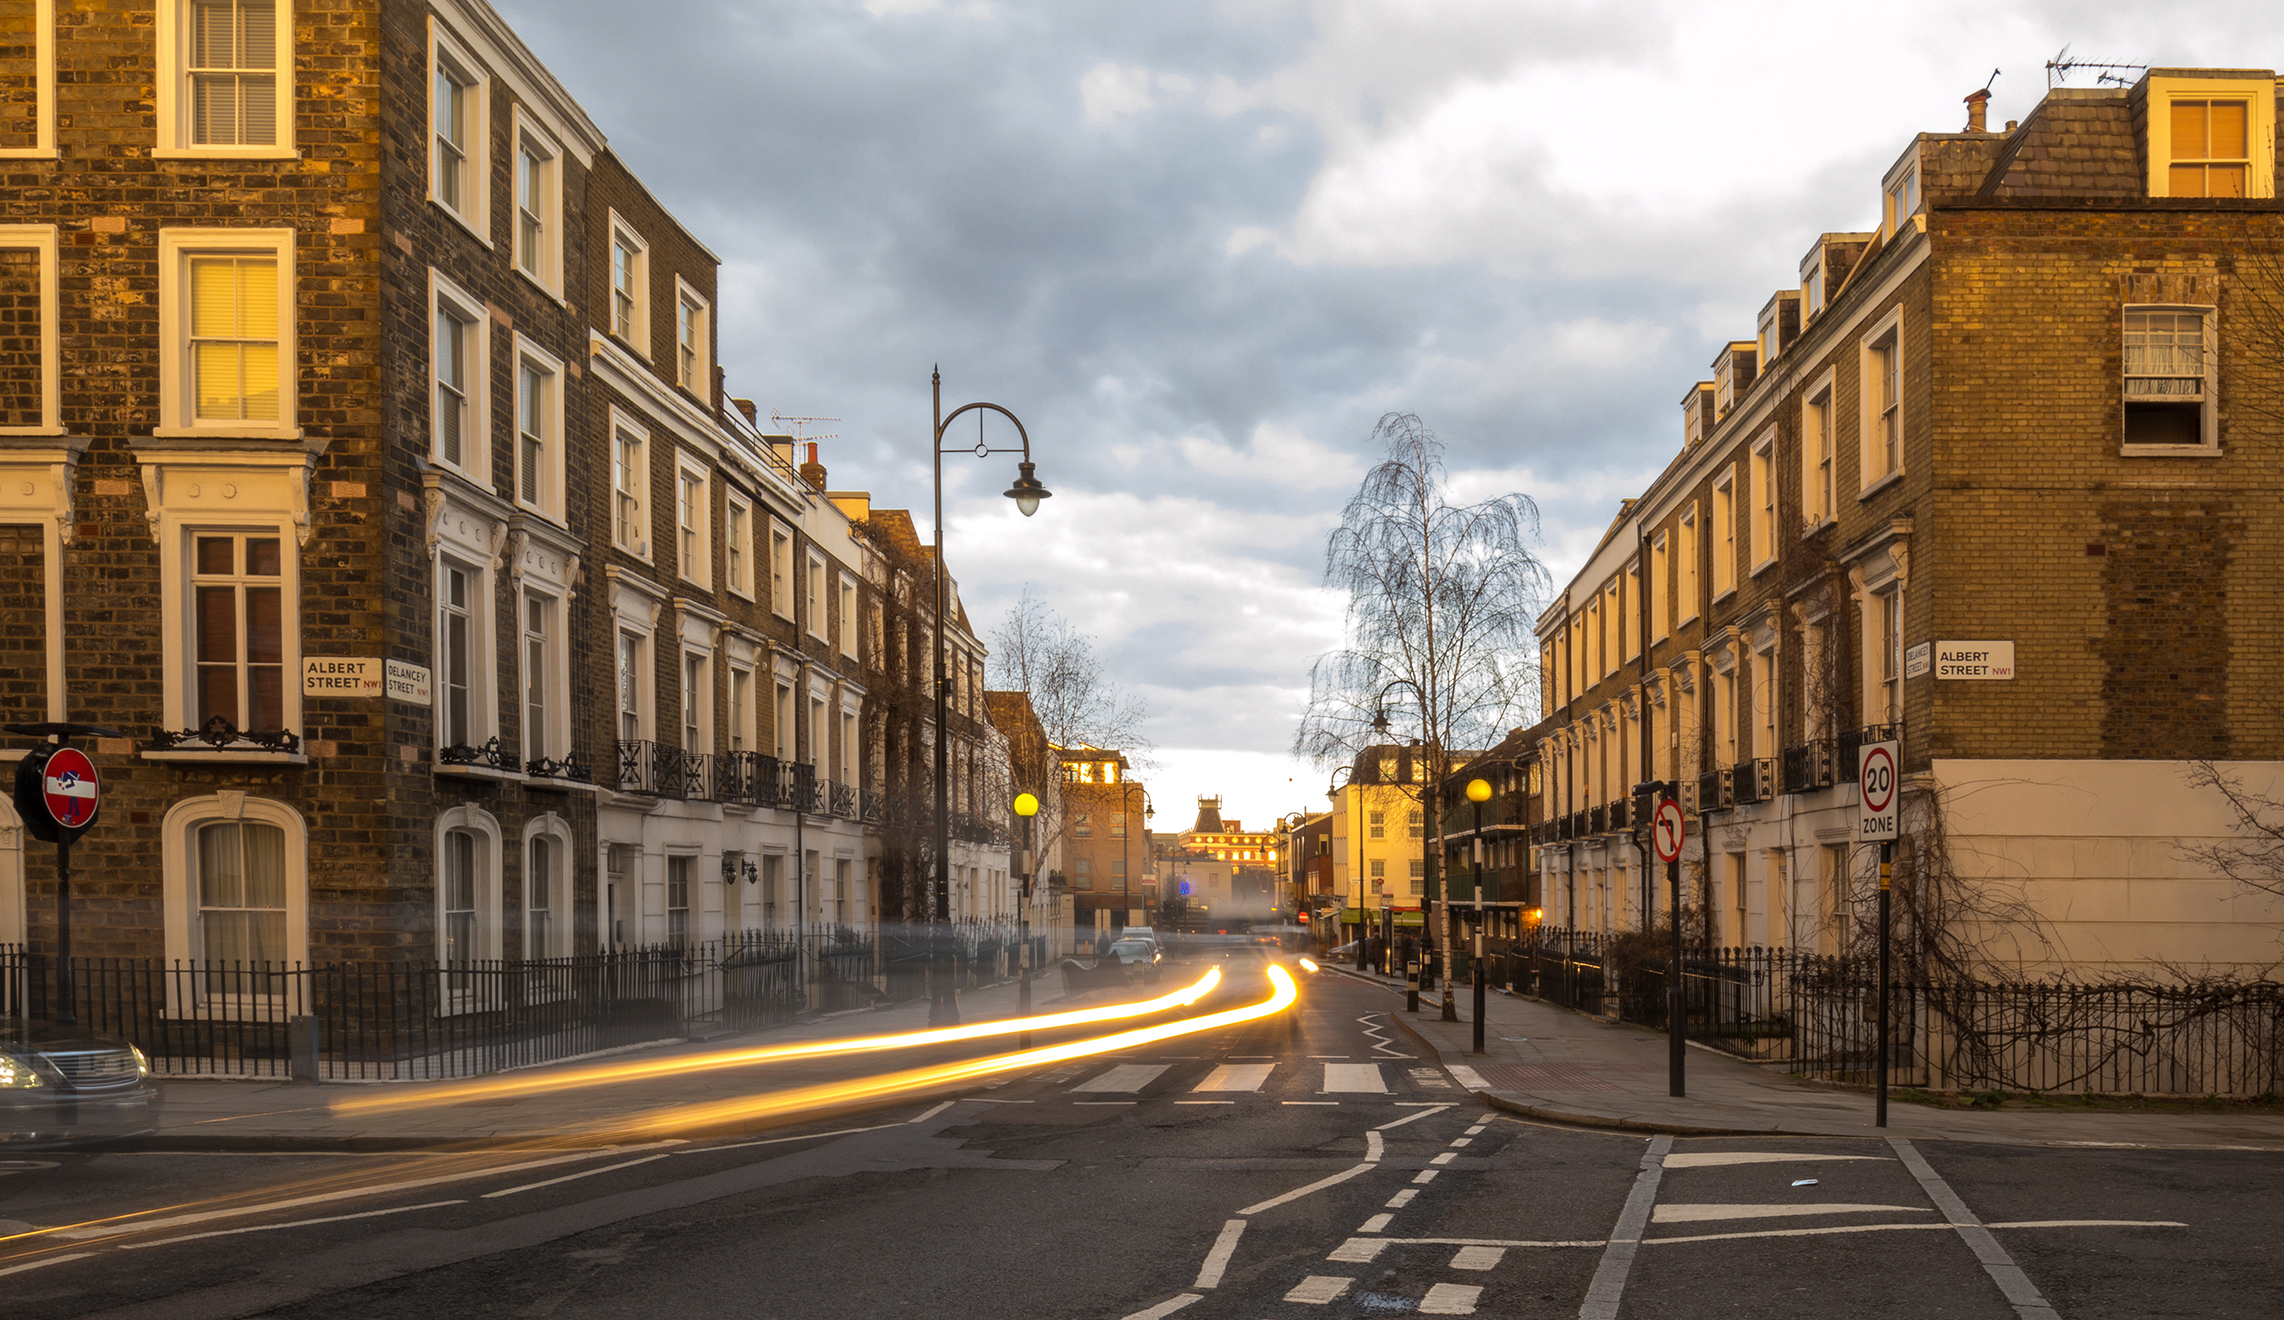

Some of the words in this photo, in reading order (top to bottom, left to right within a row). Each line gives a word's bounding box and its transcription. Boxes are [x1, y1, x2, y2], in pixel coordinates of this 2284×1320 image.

[1940, 652, 1989, 662] ALBERT
[307, 662, 365, 674] ALBERT
[388, 665, 426, 683] DELANCEY
[1940, 665, 1989, 675] STREET
[307, 677, 361, 688] STREET
[388, 680, 415, 694] STREET
[1867, 766, 1890, 793] 20
[1863, 816, 1893, 834] ZONE
